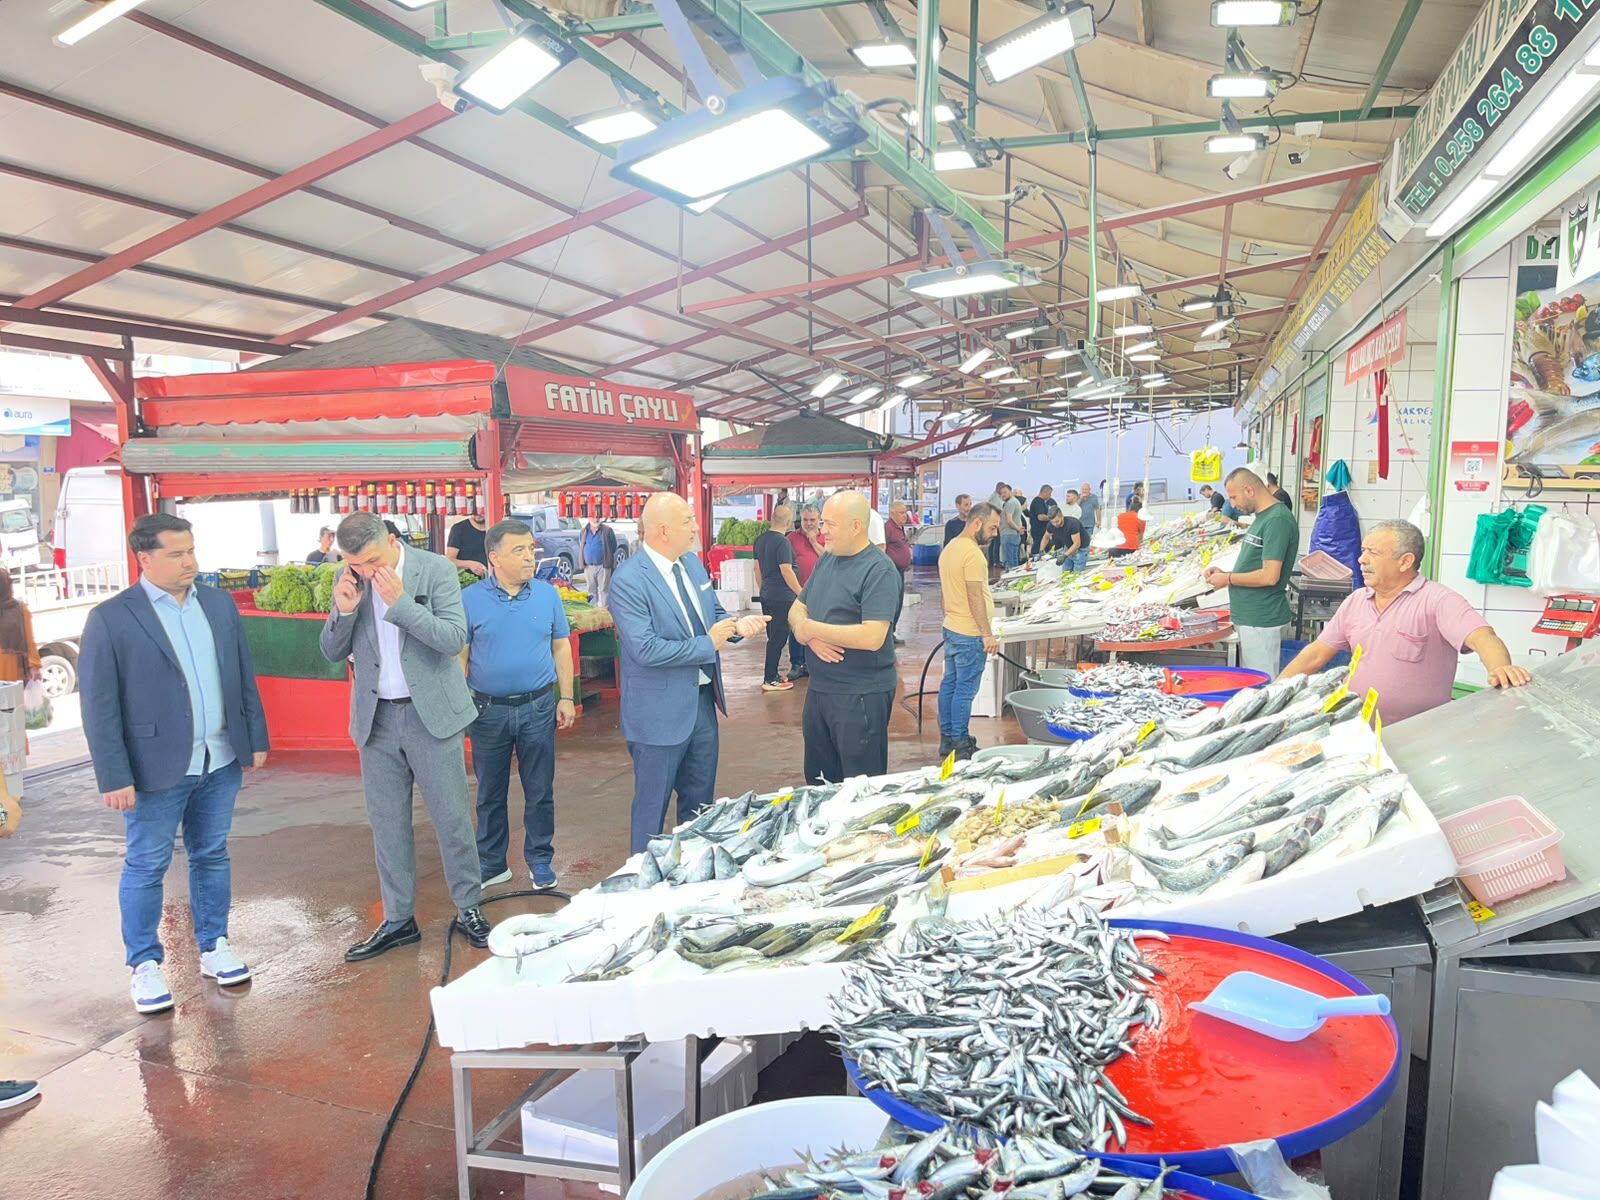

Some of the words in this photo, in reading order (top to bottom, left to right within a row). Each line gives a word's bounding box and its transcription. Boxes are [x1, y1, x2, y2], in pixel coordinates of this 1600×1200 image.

[1403, 181, 1435, 213] TEL
[1434, 118, 1484, 176] 0.258
[1477, 67, 1523, 126] 264
[1516, 25, 1558, 74] 88
[1554, 0, 1597, 23] 1
[544, 381, 615, 416] FATİH
[618, 393, 679, 424] ÇAYLI
[1397, 407, 1433, 416] KARDE
